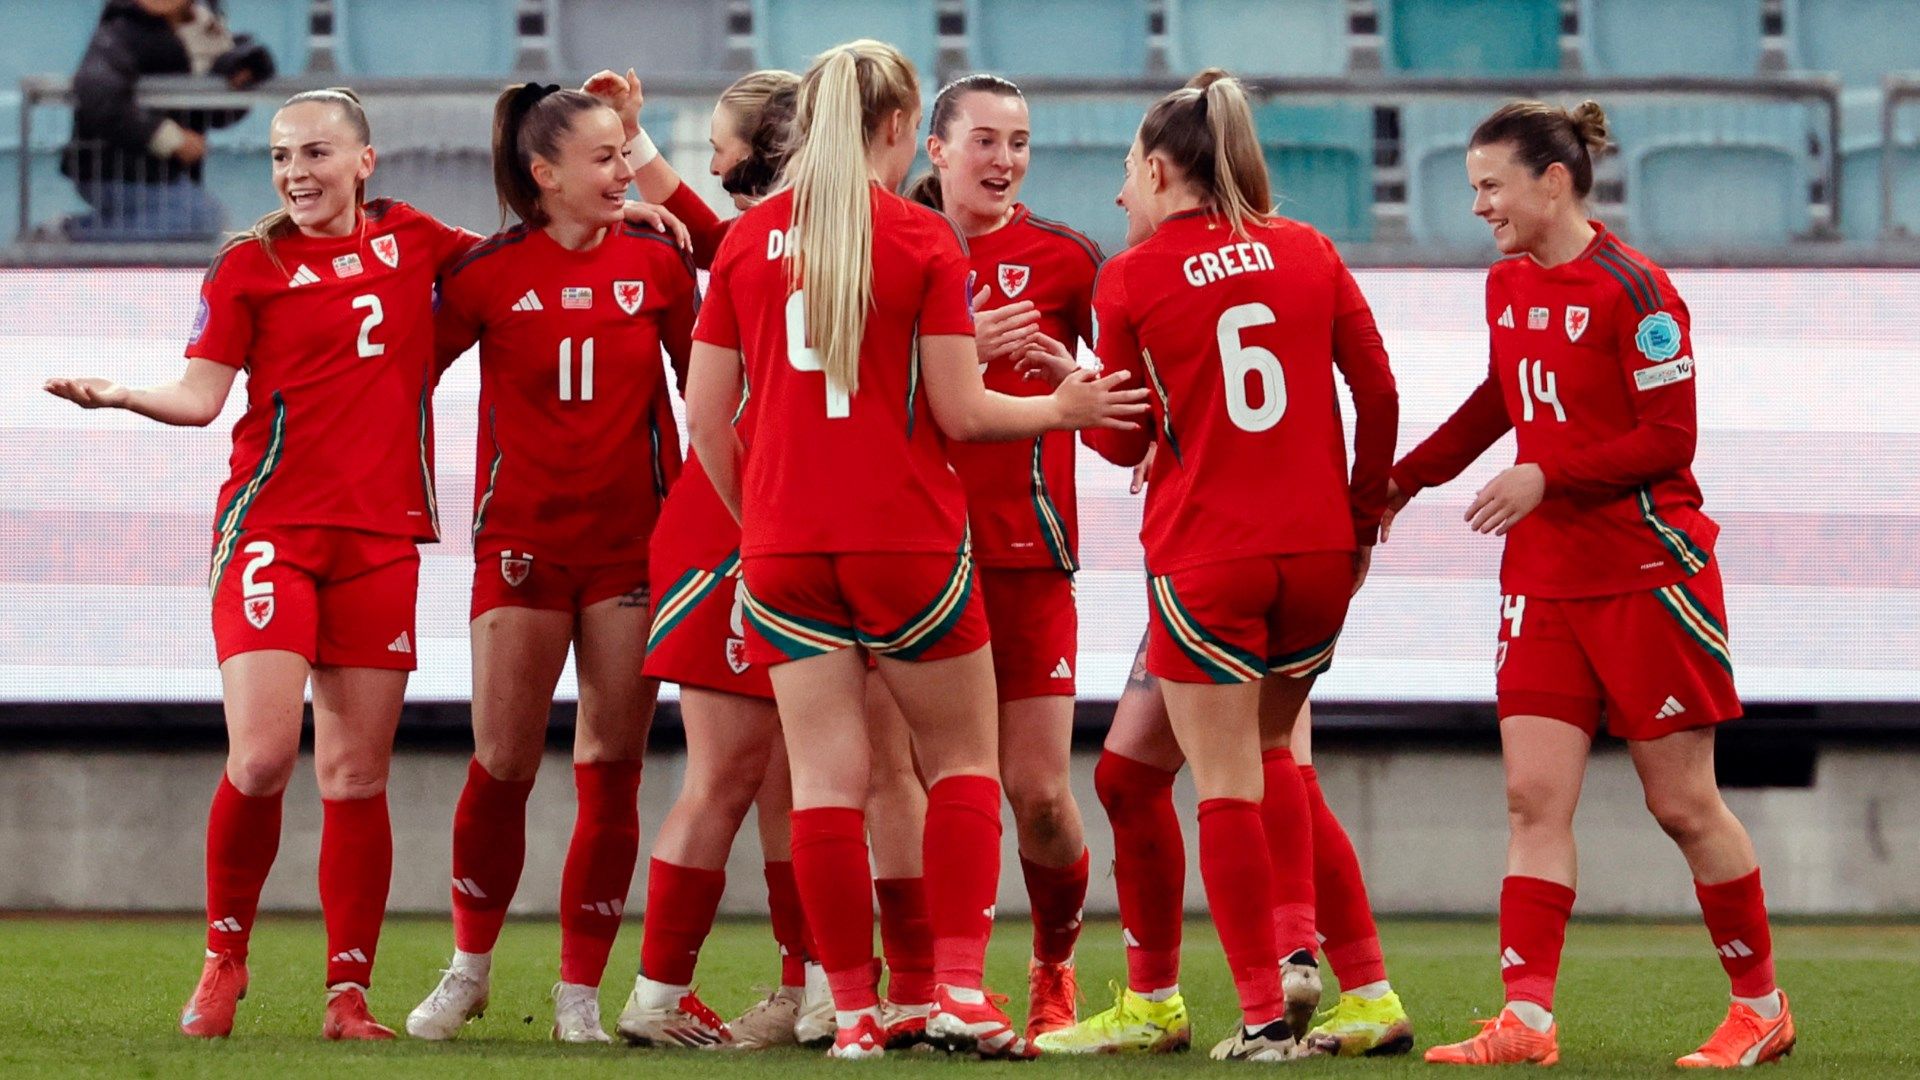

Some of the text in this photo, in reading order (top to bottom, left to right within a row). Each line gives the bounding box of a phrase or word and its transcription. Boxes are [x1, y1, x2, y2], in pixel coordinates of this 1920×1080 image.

[1183, 242, 1275, 287] GREEN
[352, 294, 385, 358] 2
[559, 337, 594, 400] 11
[1217, 302, 1288, 432] 6
[1518, 357, 1567, 422] 14
[242, 541, 275, 598] 2
[1500, 594, 1526, 638] 4
